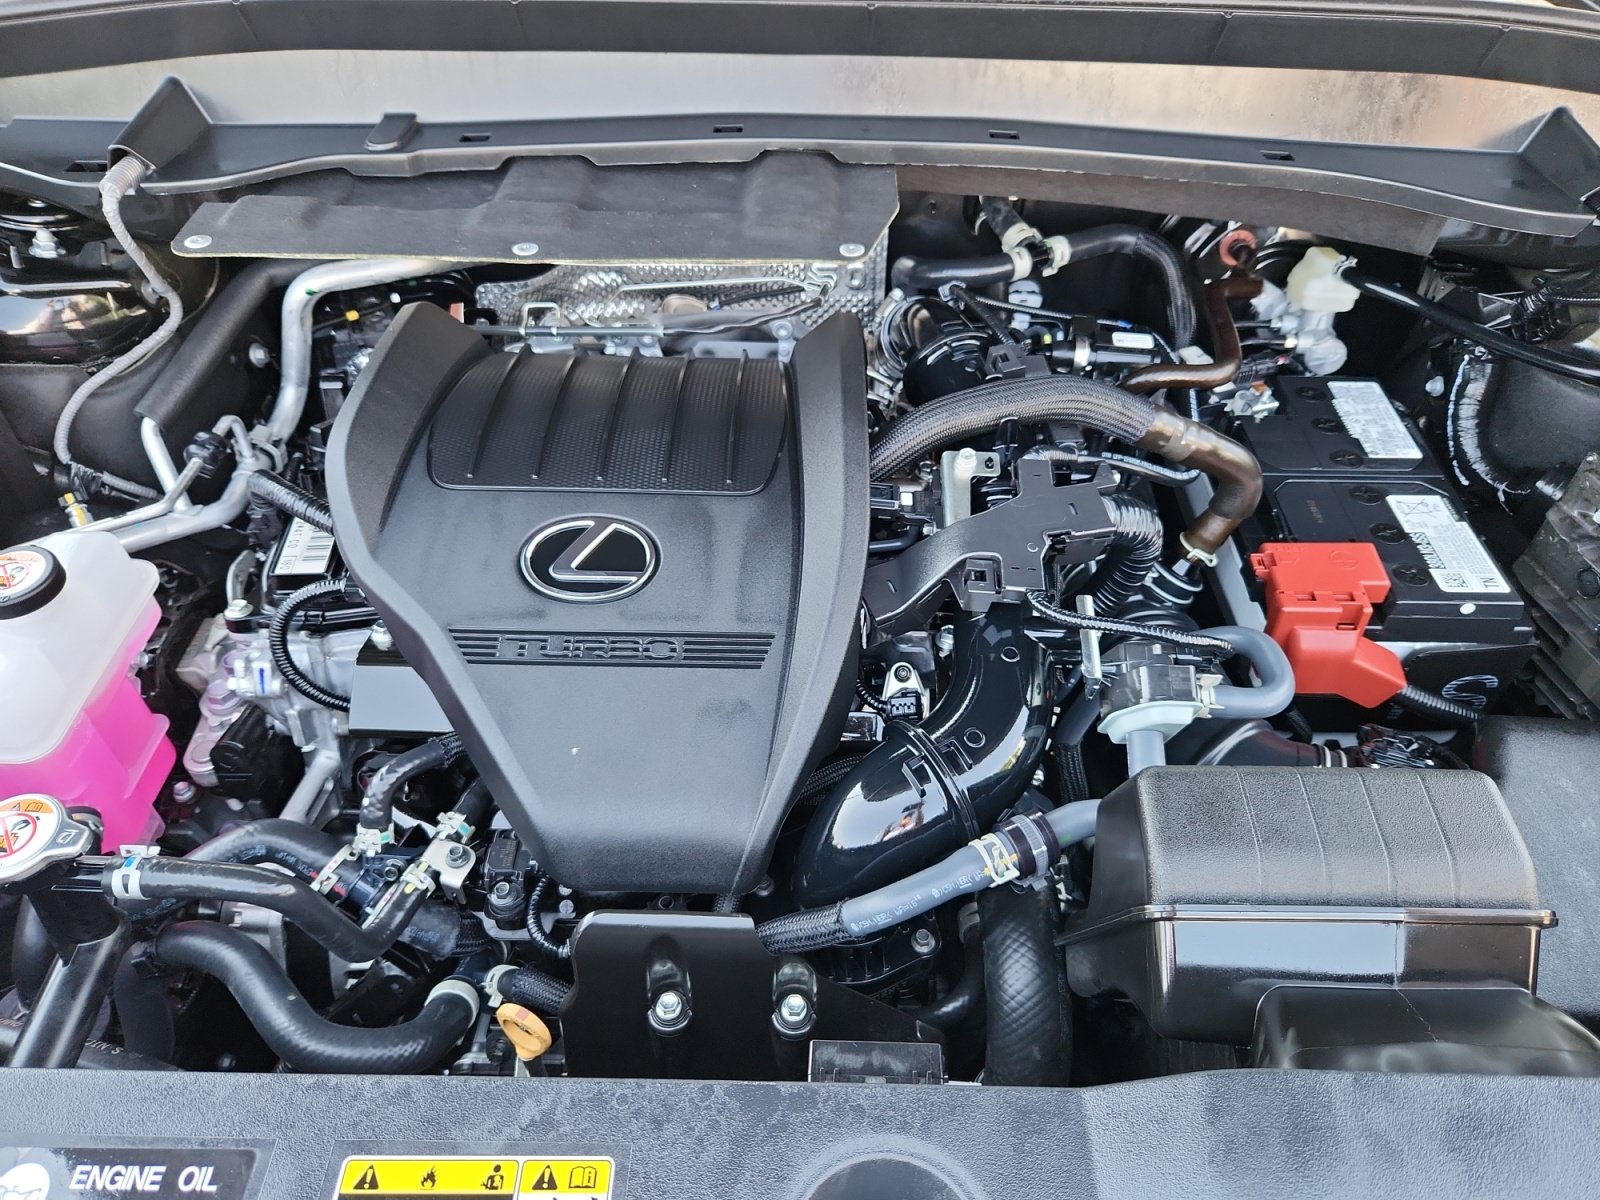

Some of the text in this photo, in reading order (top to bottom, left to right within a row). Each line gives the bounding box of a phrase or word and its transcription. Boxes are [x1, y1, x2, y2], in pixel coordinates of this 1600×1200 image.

[500, 633, 679, 660] TURBO
[69, 1164, 218, 1192] ENGINE OIL
